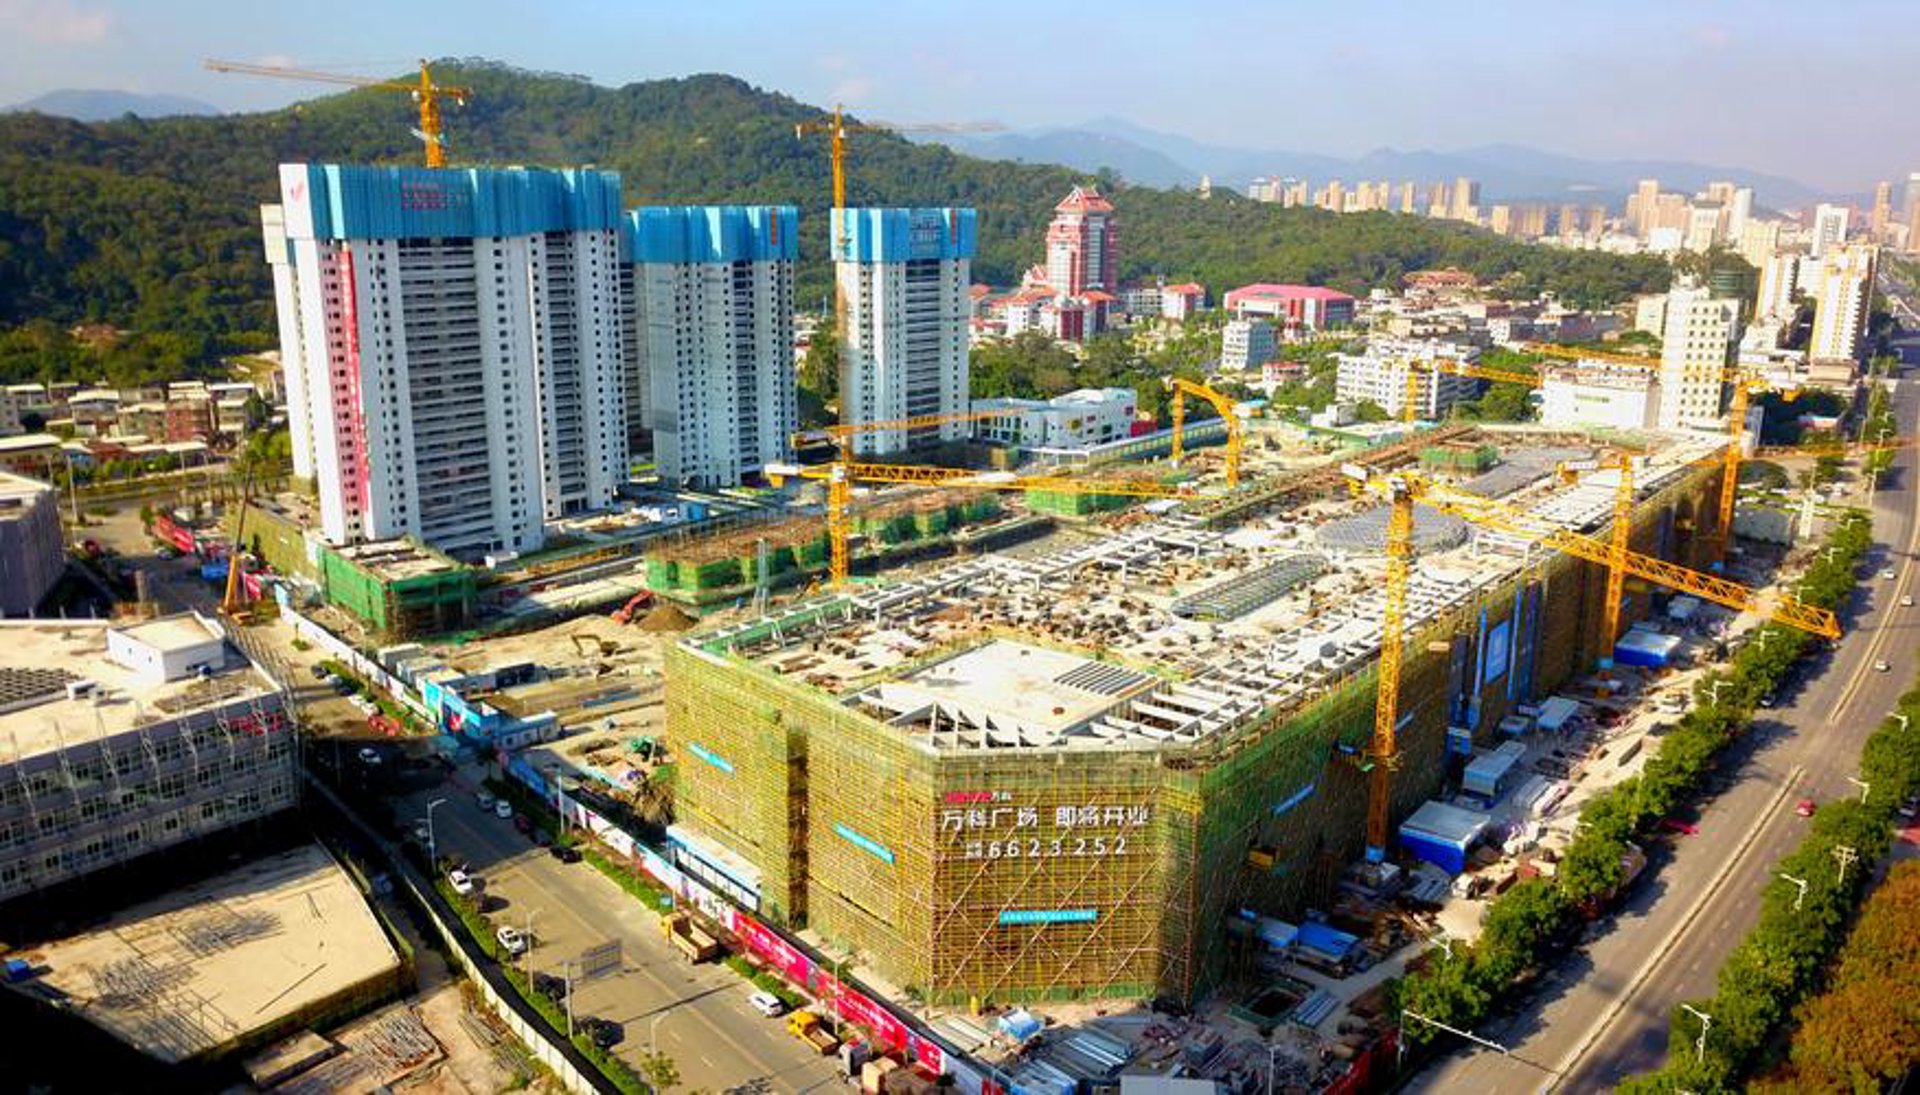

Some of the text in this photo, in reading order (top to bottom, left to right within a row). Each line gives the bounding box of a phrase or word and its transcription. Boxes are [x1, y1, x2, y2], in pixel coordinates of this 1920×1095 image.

[942, 805, 1150, 831] 万科广场 即将开业
